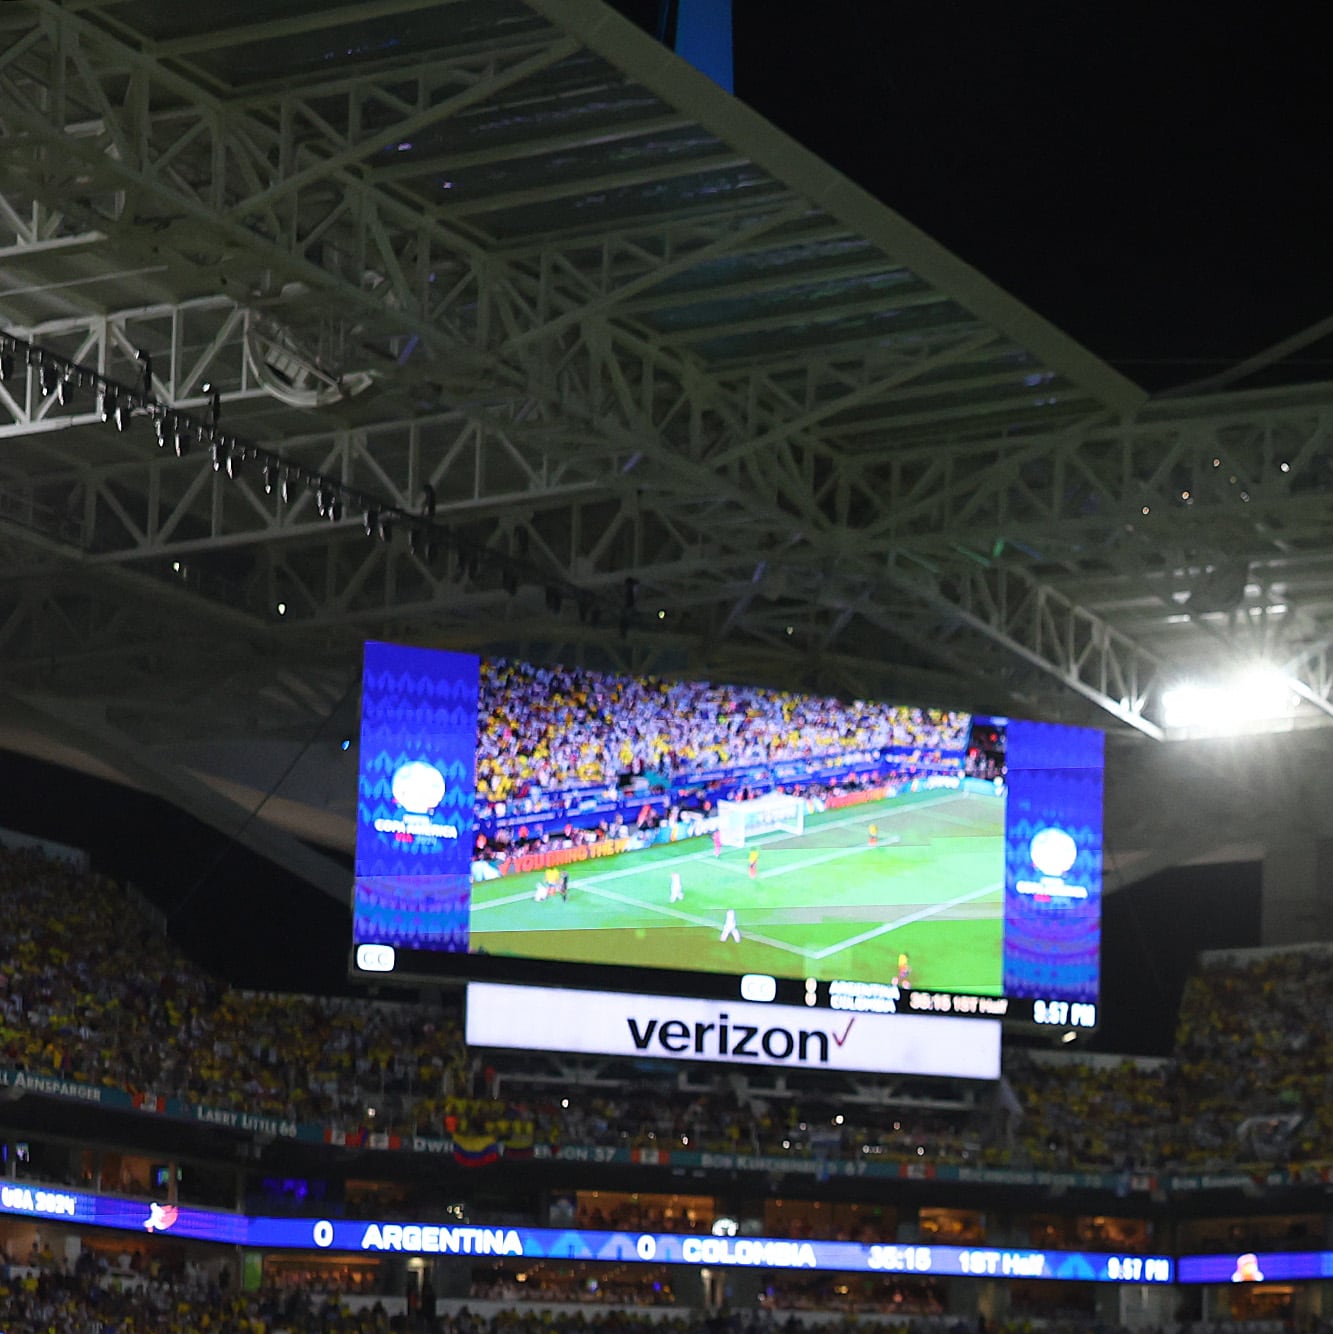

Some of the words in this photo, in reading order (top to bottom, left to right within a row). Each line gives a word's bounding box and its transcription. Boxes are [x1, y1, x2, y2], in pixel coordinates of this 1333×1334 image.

[627, 1013, 829, 1062] verizon
[313, 1220, 334, 1248] 0
[361, 1223, 524, 1256] ARGENTINA
[637, 1235, 656, 1260] 0
[683, 1238, 817, 1268] COLOMBIA
